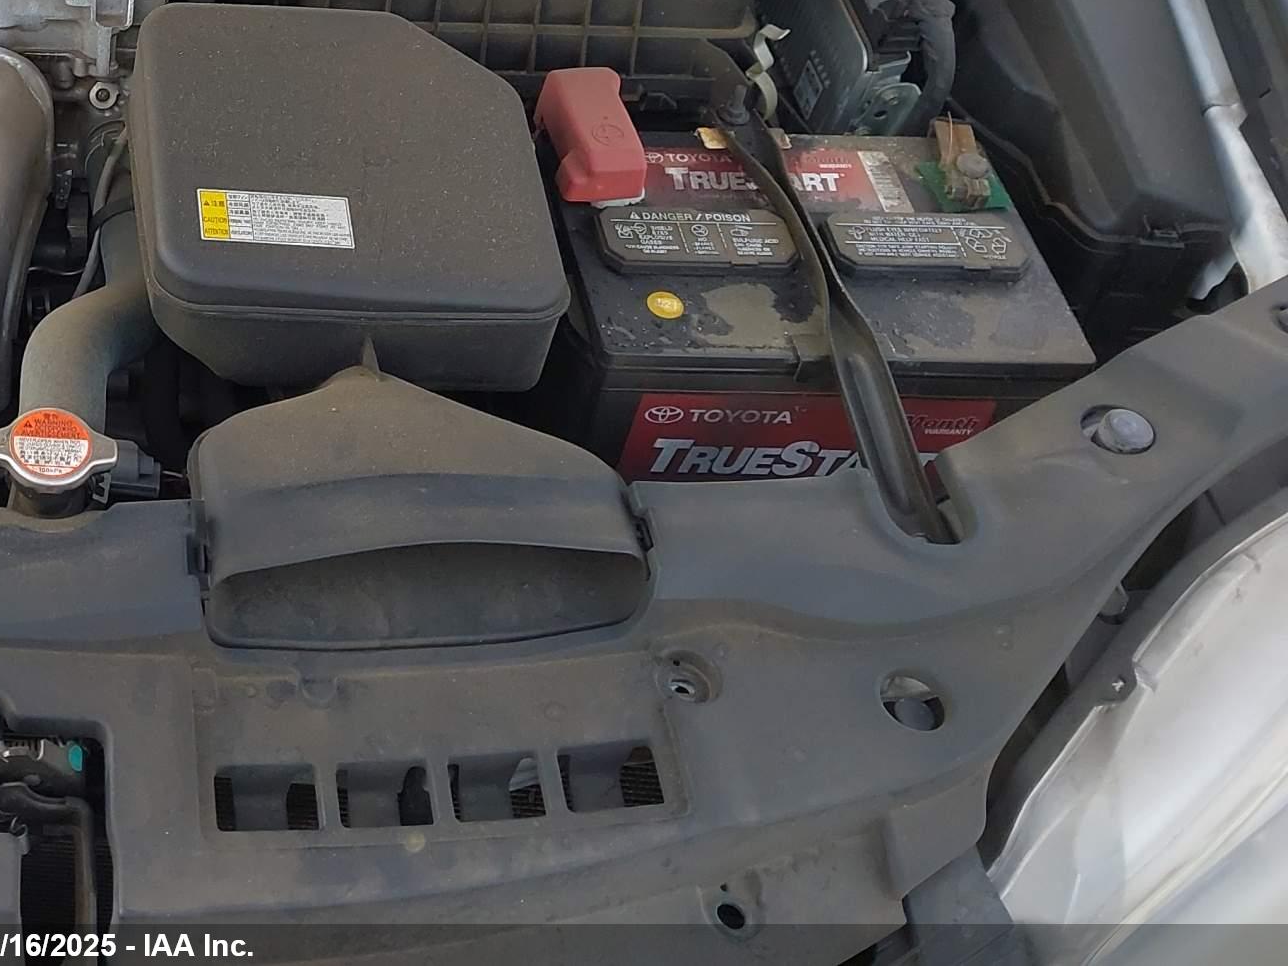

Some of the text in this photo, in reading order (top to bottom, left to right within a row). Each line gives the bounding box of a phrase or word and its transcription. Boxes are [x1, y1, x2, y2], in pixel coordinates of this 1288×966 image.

[664, 152, 732, 164] TOYOTA
[642, 212, 693, 222] DANGER
[704, 213, 751, 223] POISON
[690, 408, 793, 424] TOYOTA
